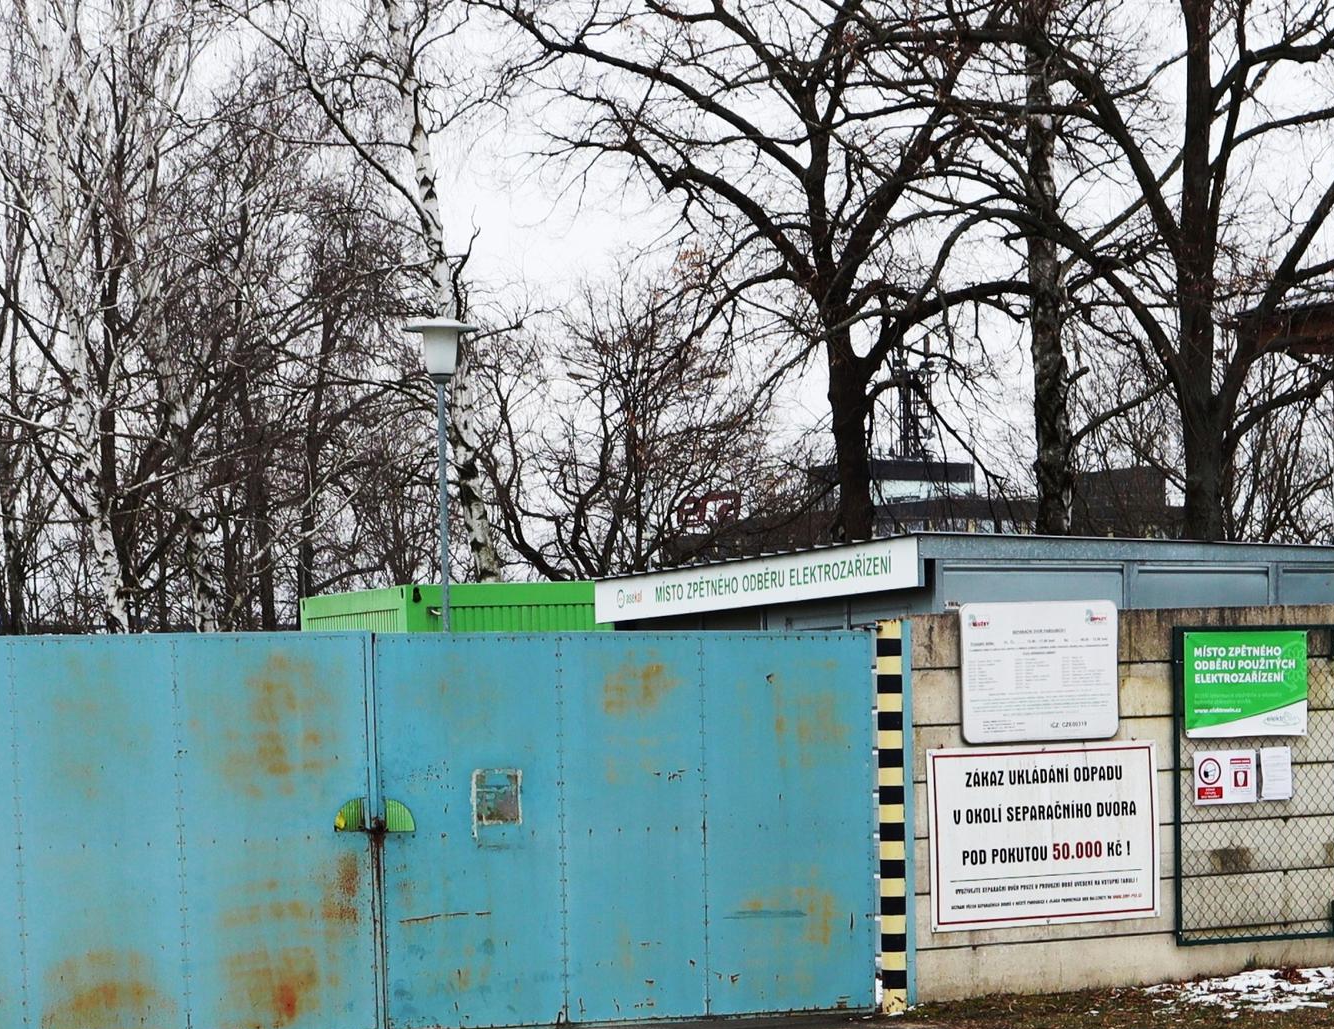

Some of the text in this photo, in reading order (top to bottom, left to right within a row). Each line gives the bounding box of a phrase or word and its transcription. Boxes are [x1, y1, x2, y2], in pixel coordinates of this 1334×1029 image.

[655, 550, 892, 603] MÍSTO ZPĚTNÉHO ODBĚRU ELEKTROZAŘÍZENÍ
[1193, 644, 1282, 658] MÍSTO ZPĚTNÉHO
[1194, 657, 1296, 670] ODBĚRU POUŽITÝCH
[1194, 670, 1284, 684] ELEKTROZAŘÍZENÍ
[965, 763, 1123, 788] ZÁKAZ UKLÁDÁNÍ ODPADU
[953, 800, 1137, 825] V OKOLÍ SEPARAČNÍHO DVORA
[962, 849, 987, 866] POD
[991, 846, 1048, 864] POKUTOU
[1052, 841, 1103, 861] 50.000
